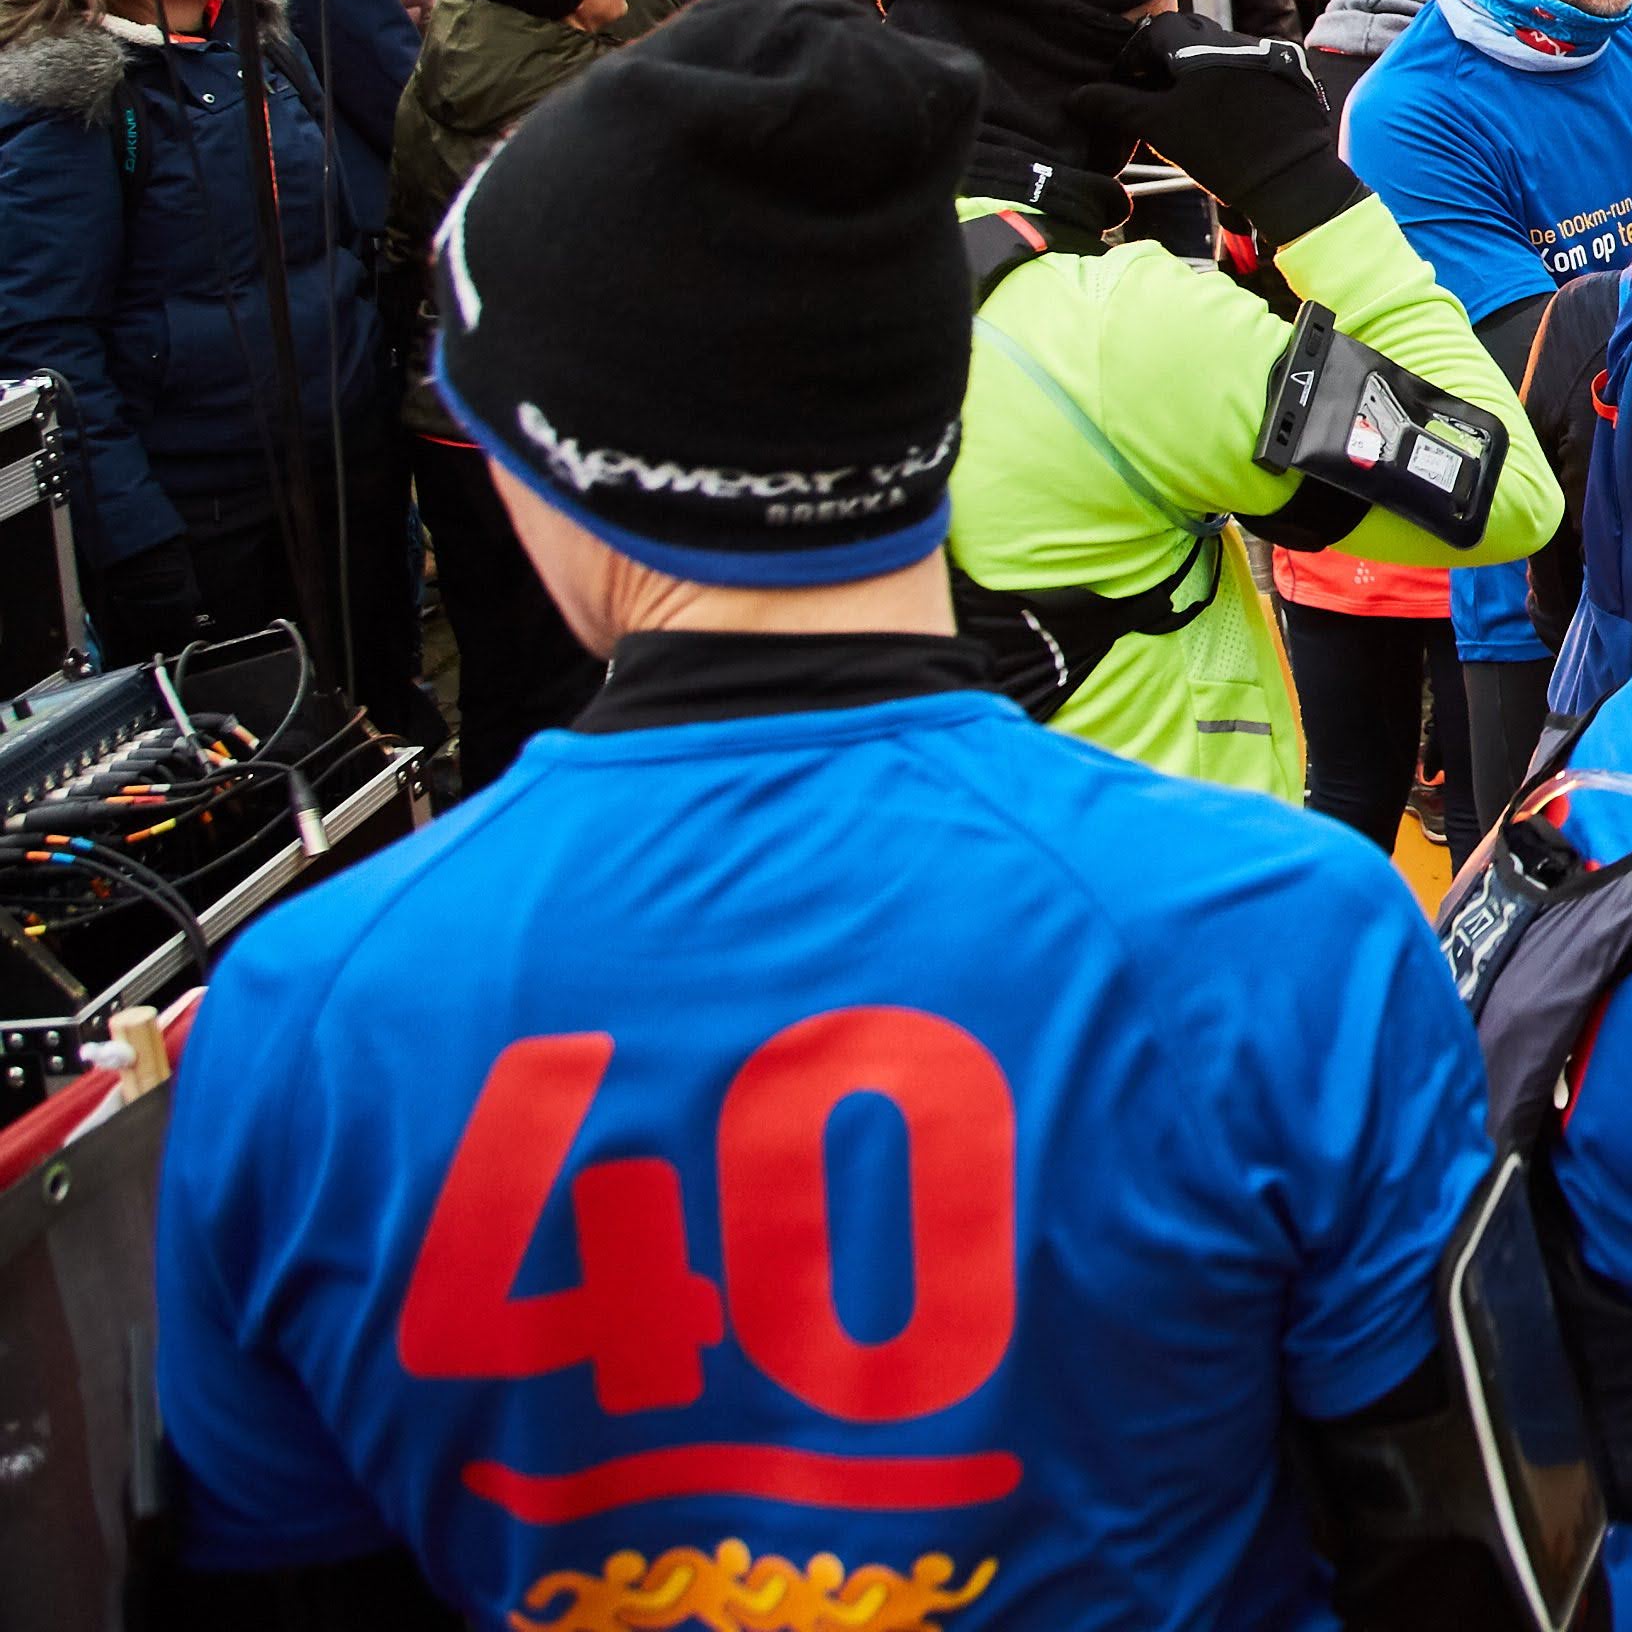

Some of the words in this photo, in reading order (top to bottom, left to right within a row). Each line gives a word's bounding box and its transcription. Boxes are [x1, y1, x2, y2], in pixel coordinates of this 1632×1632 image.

[1530, 228, 1557, 245] De
[1592, 232, 1616, 263] op
[395, 1004, 1018, 1424] 40
